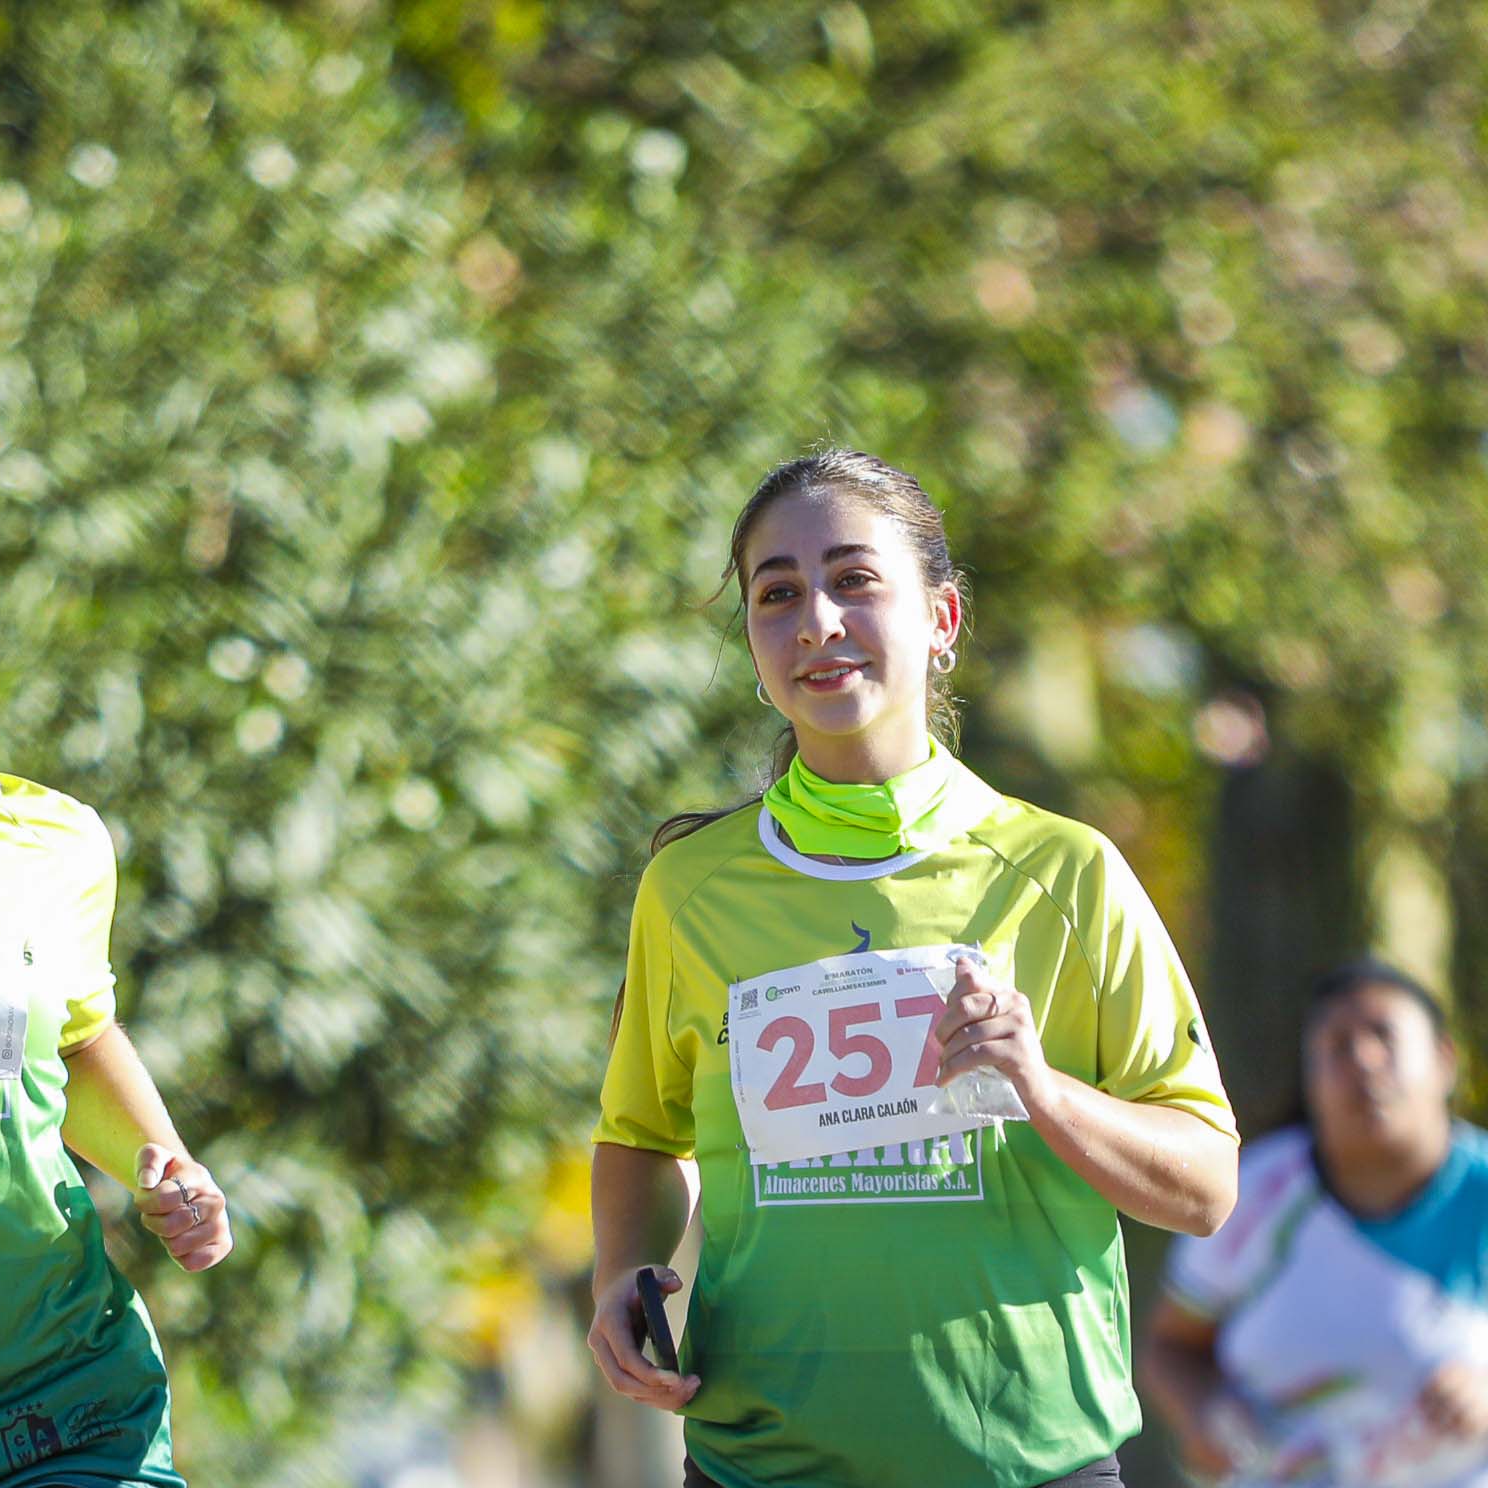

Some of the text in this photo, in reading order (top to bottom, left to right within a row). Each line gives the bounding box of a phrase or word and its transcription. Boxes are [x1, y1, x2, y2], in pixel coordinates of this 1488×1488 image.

[756, 993, 951, 1111] 257
[819, 1098, 918, 1127] ANA CLARA CALAÓN
[764, 1170, 972, 1195] Almacenes Mayoristas S.A.
